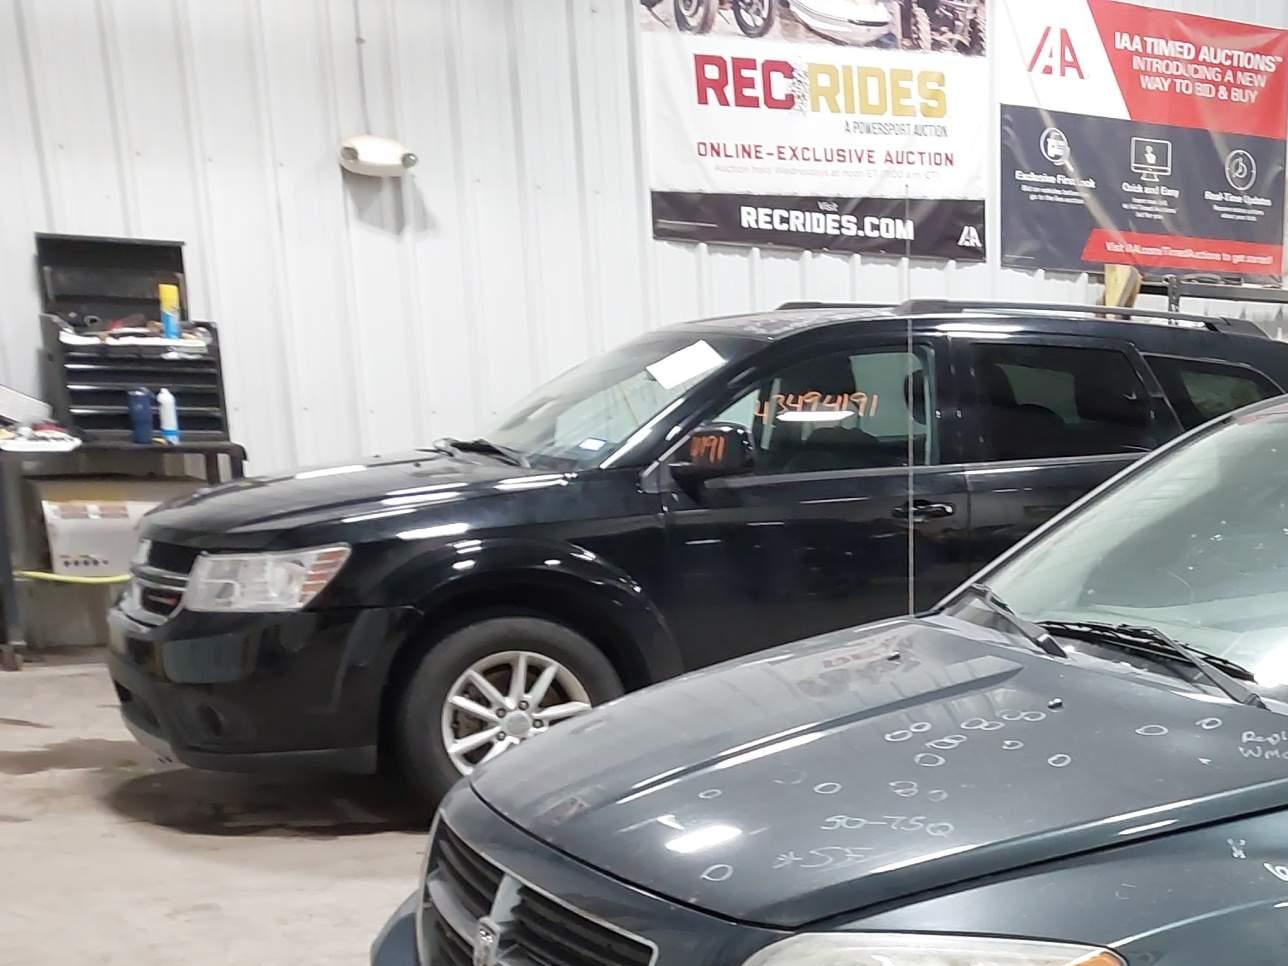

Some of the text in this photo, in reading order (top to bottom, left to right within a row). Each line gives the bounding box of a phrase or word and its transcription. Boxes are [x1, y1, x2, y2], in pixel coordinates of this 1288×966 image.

[1114, 31, 1141, 53] IAA
[1143, 35, 1196, 60] TIMED
[694, 53, 948, 118] REC RIDES
[1132, 56, 1267, 88] INTRODUCING A NEW
[1140, 74, 1172, 92] WAY
[1174, 79, 1193, 95] TO
[1217, 86, 1229, 101] &
[1231, 87, 1259, 104] BUY
[913, 124, 949, 138] AUCTION
[697, 141, 955, 167] ONLINE-EXCLUSIVE AUCTION
[740, 206, 915, 240] RECRIDES.COM
